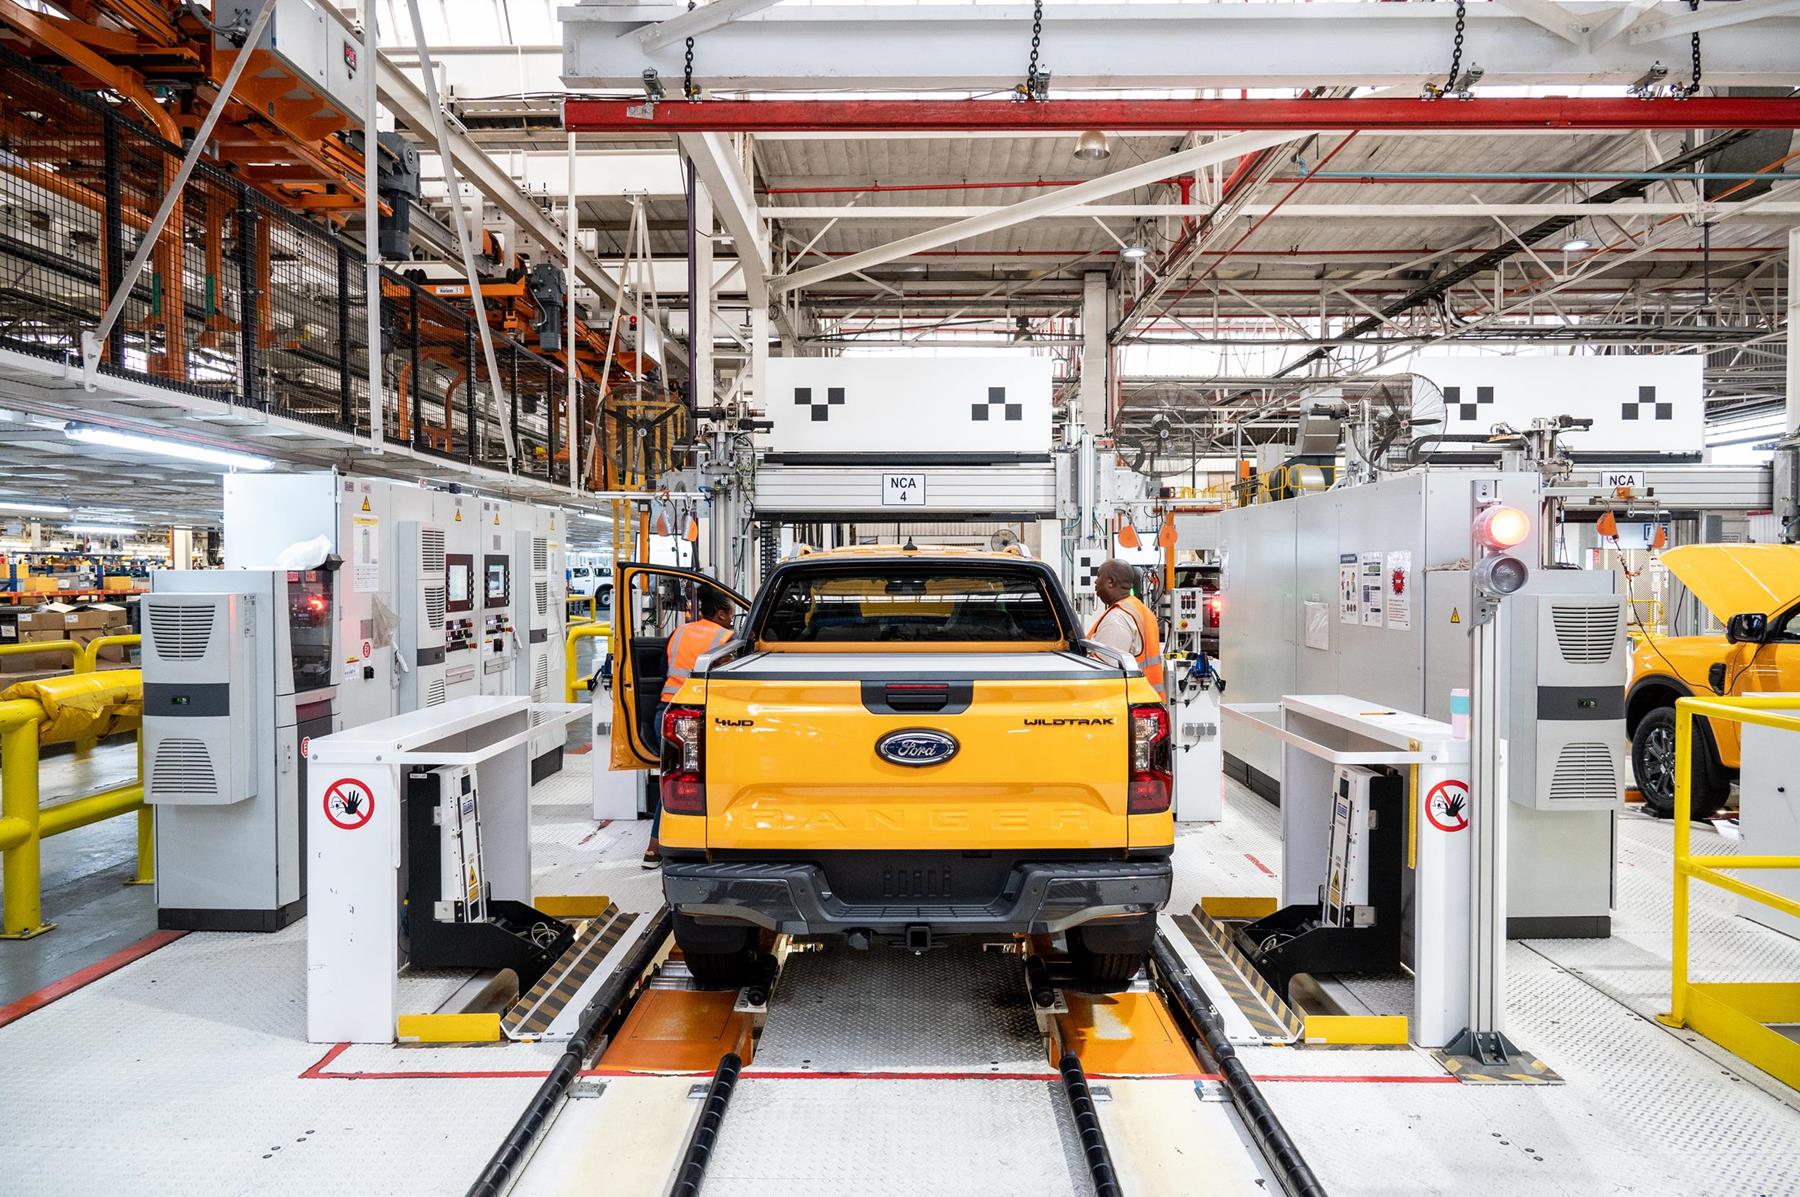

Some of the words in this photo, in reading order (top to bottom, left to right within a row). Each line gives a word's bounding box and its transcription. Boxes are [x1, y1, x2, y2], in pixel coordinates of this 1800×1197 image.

[890, 477, 916, 488] NCA
[1609, 474, 1635, 486] NCA
[900, 490, 907, 502] 4
[714, 717, 754, 727] 4WD
[1023, 718, 1114, 726] WILDTRAK
[897, 739, 937, 757] Ford
[742, 808, 1090, 832] RANGER
